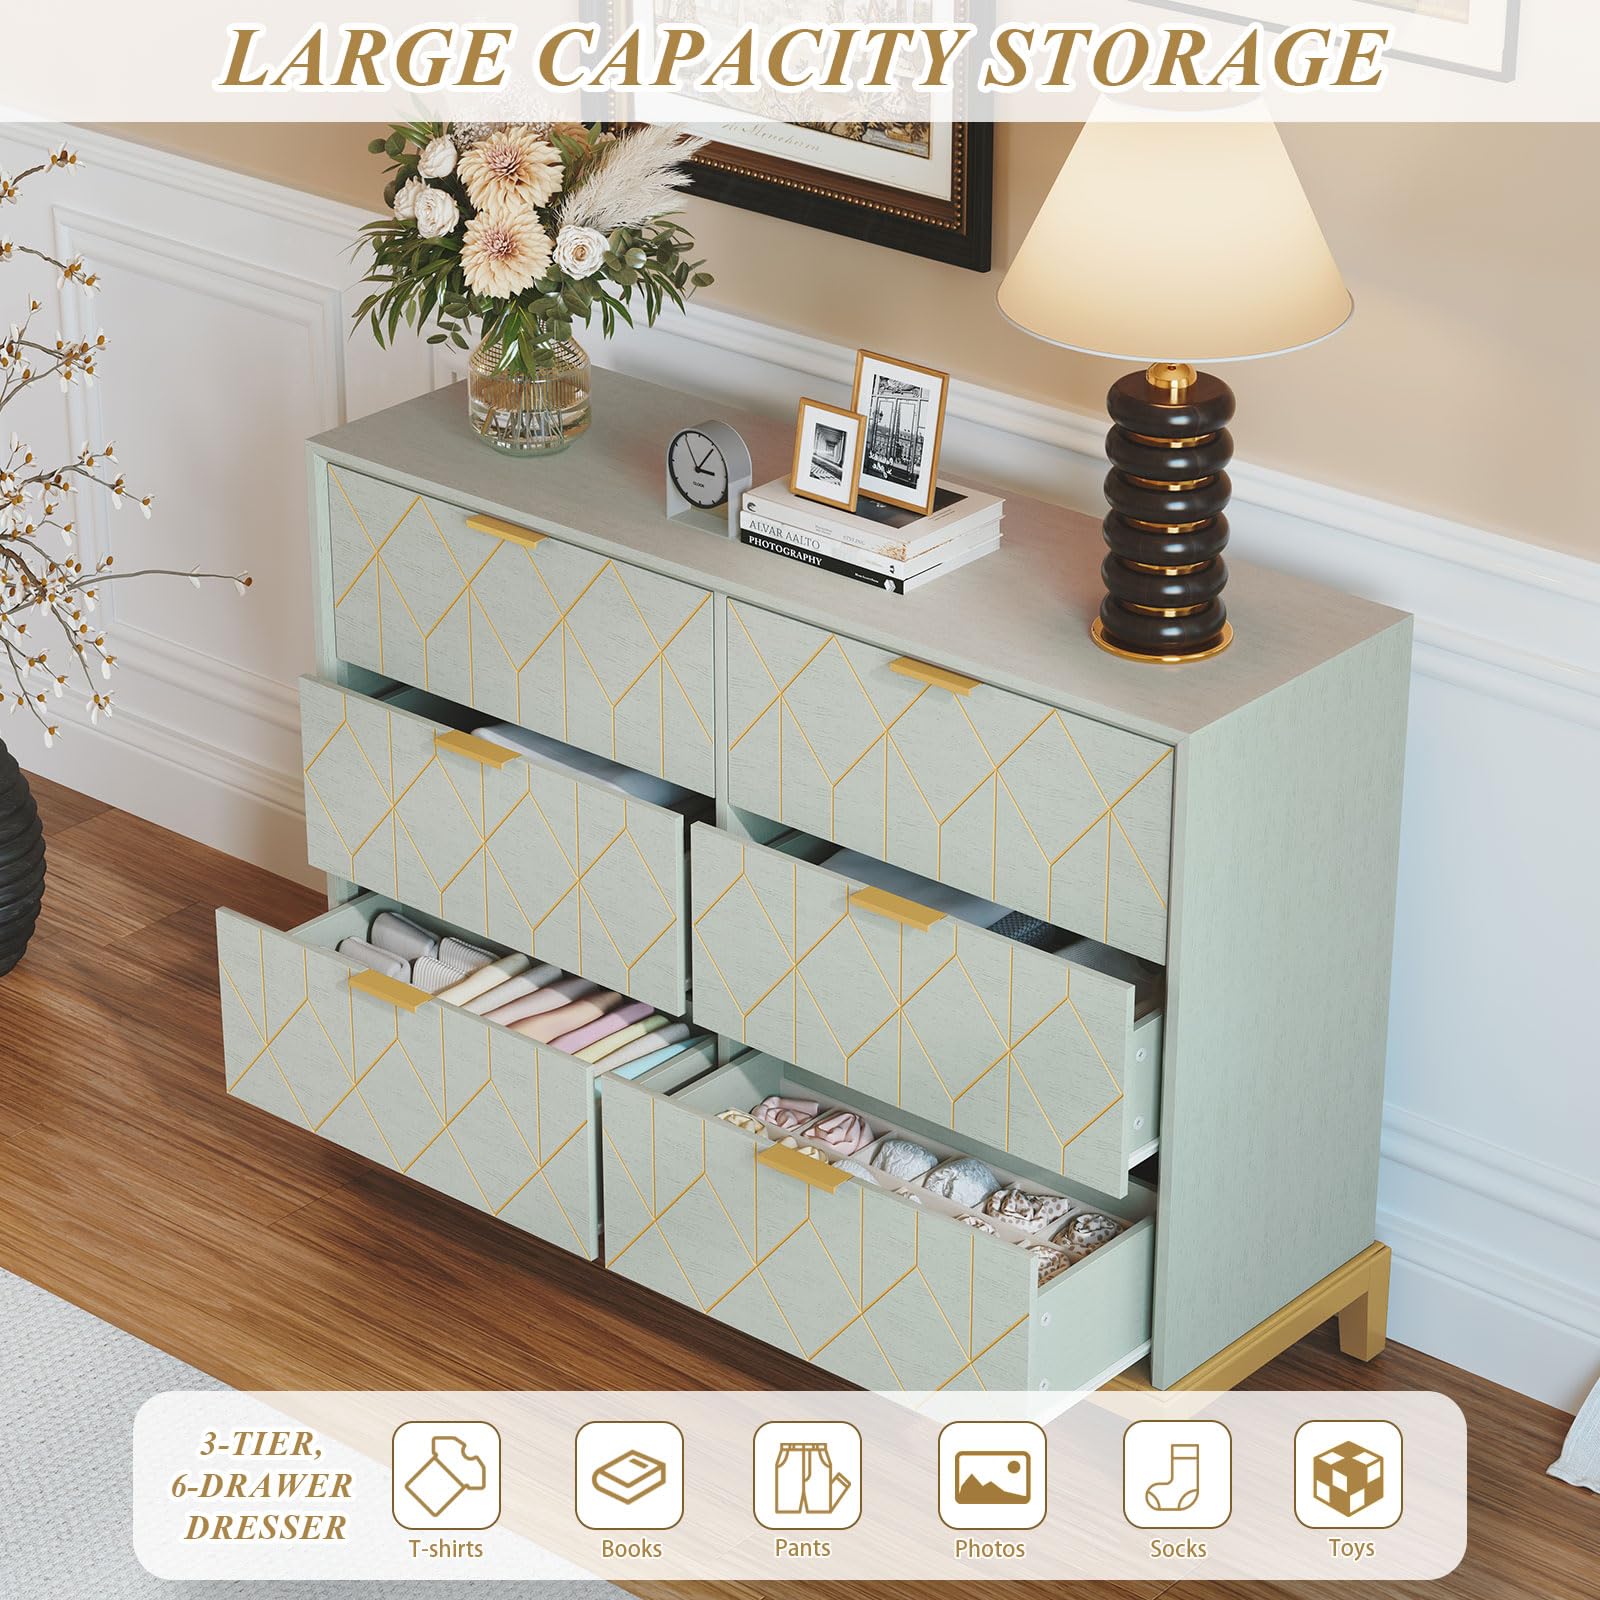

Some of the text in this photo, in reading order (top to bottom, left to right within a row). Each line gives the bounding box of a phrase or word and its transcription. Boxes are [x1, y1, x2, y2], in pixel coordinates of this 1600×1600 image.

[749, 520, 820, 550] ALVAR AALTO
[748, 535, 823, 566] PHOTOGRAPHY
